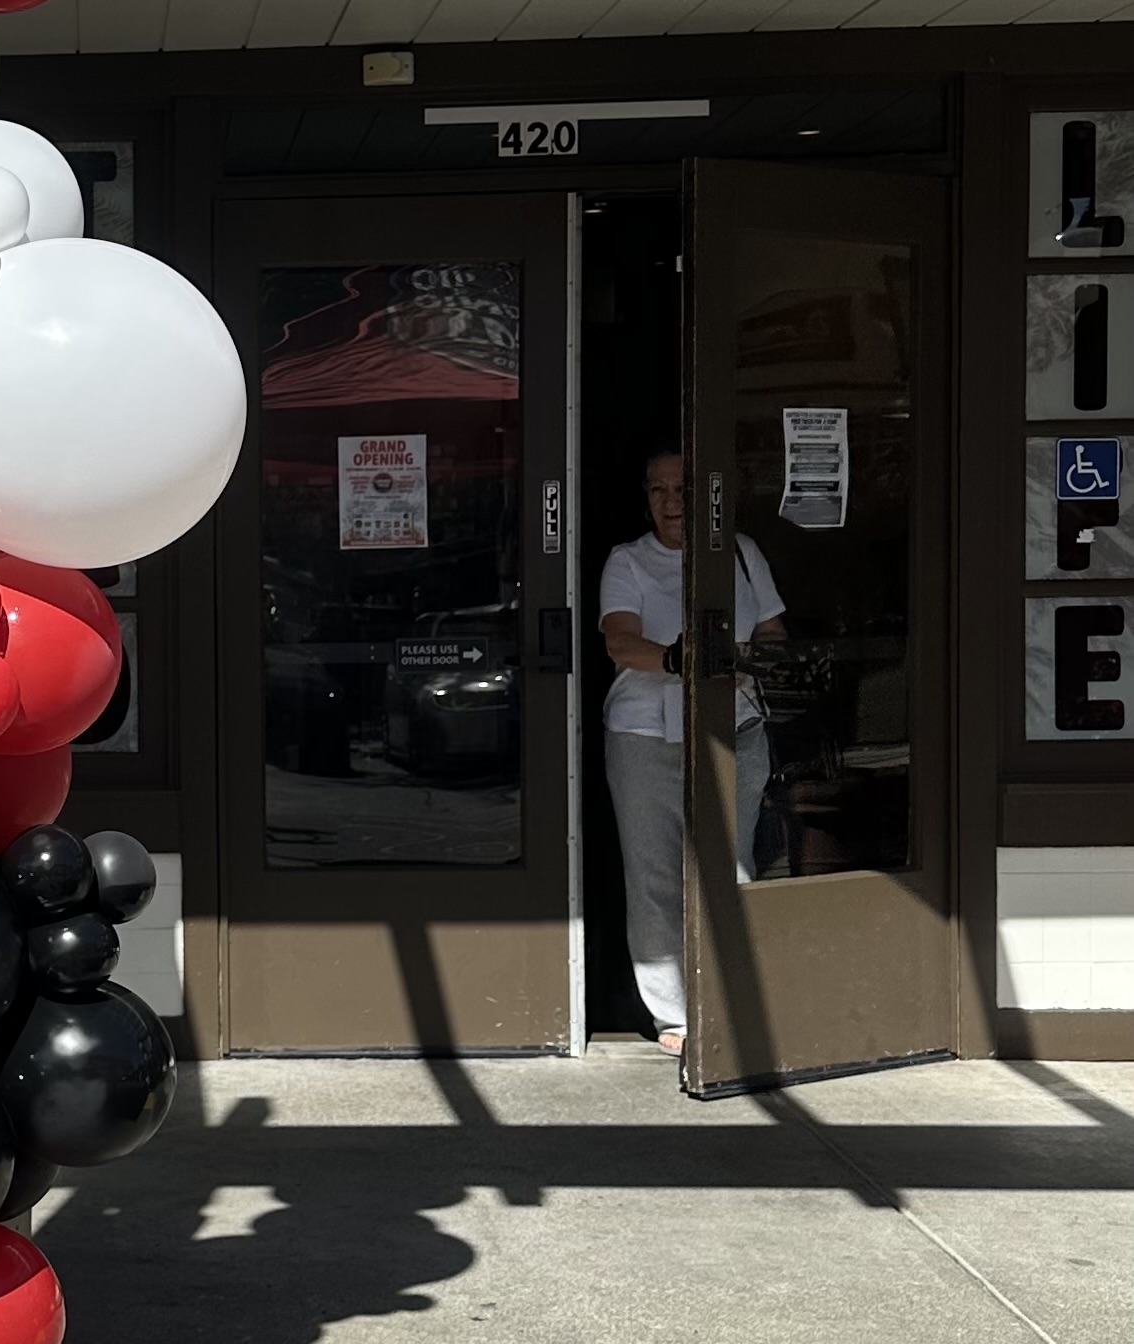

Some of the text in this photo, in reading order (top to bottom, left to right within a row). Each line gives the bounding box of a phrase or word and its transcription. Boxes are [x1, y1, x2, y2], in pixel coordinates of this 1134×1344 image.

[501, 120, 576, 155] 420
[360, 440, 406, 453] GRAND
[353, 452, 414, 466] OPENING
[546, 486, 557, 536] PULL
[711, 479, 721, 532] PULL
[401, 644, 459, 655] PLEASE USE
[401, 656, 460, 665] OTHER DOOR
